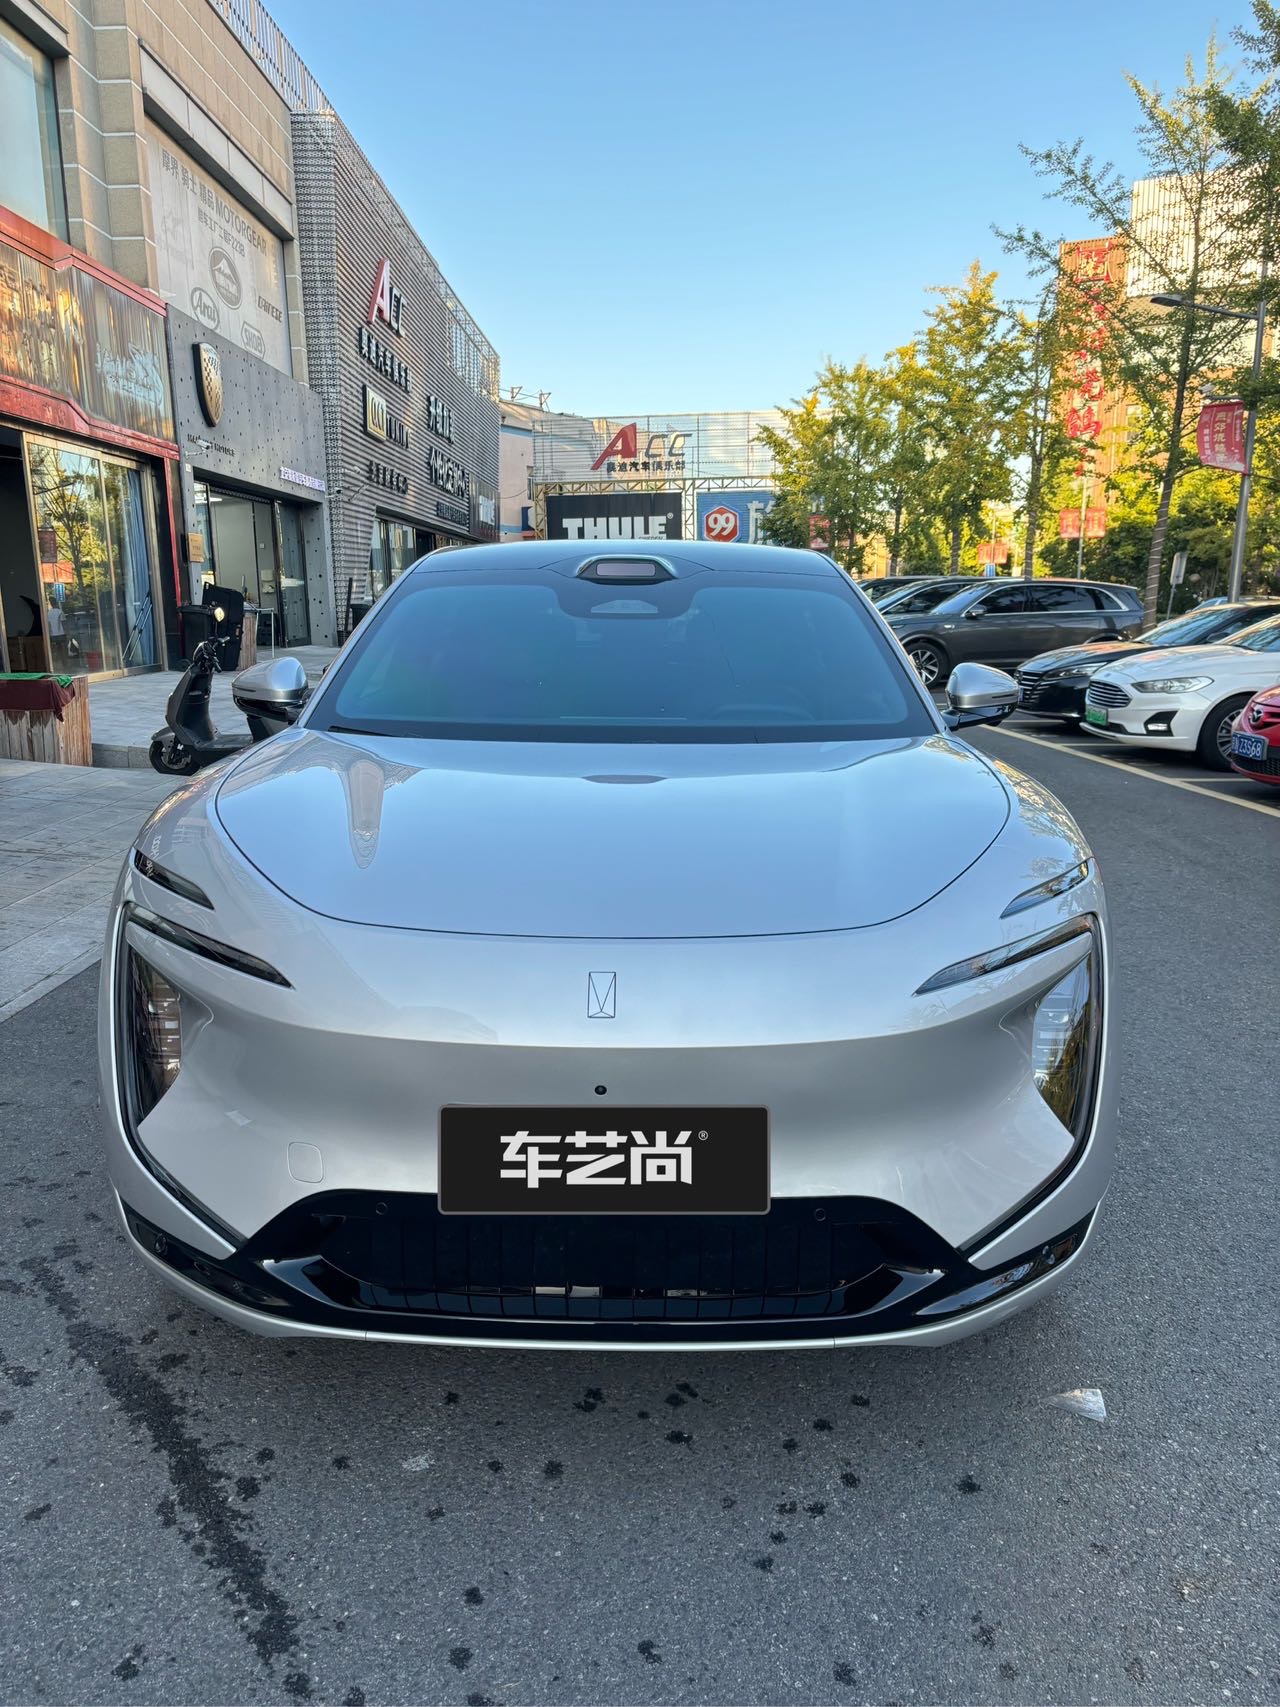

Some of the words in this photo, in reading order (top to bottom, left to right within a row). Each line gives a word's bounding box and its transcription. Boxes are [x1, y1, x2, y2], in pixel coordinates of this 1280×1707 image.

[215, 196, 267, 256] MOTORGEAR
[193, 291, 216, 324] Arai
[591, 423, 692, 470] ACC
[562, 516, 667, 540] THULE
[708, 513, 735, 536] 99
